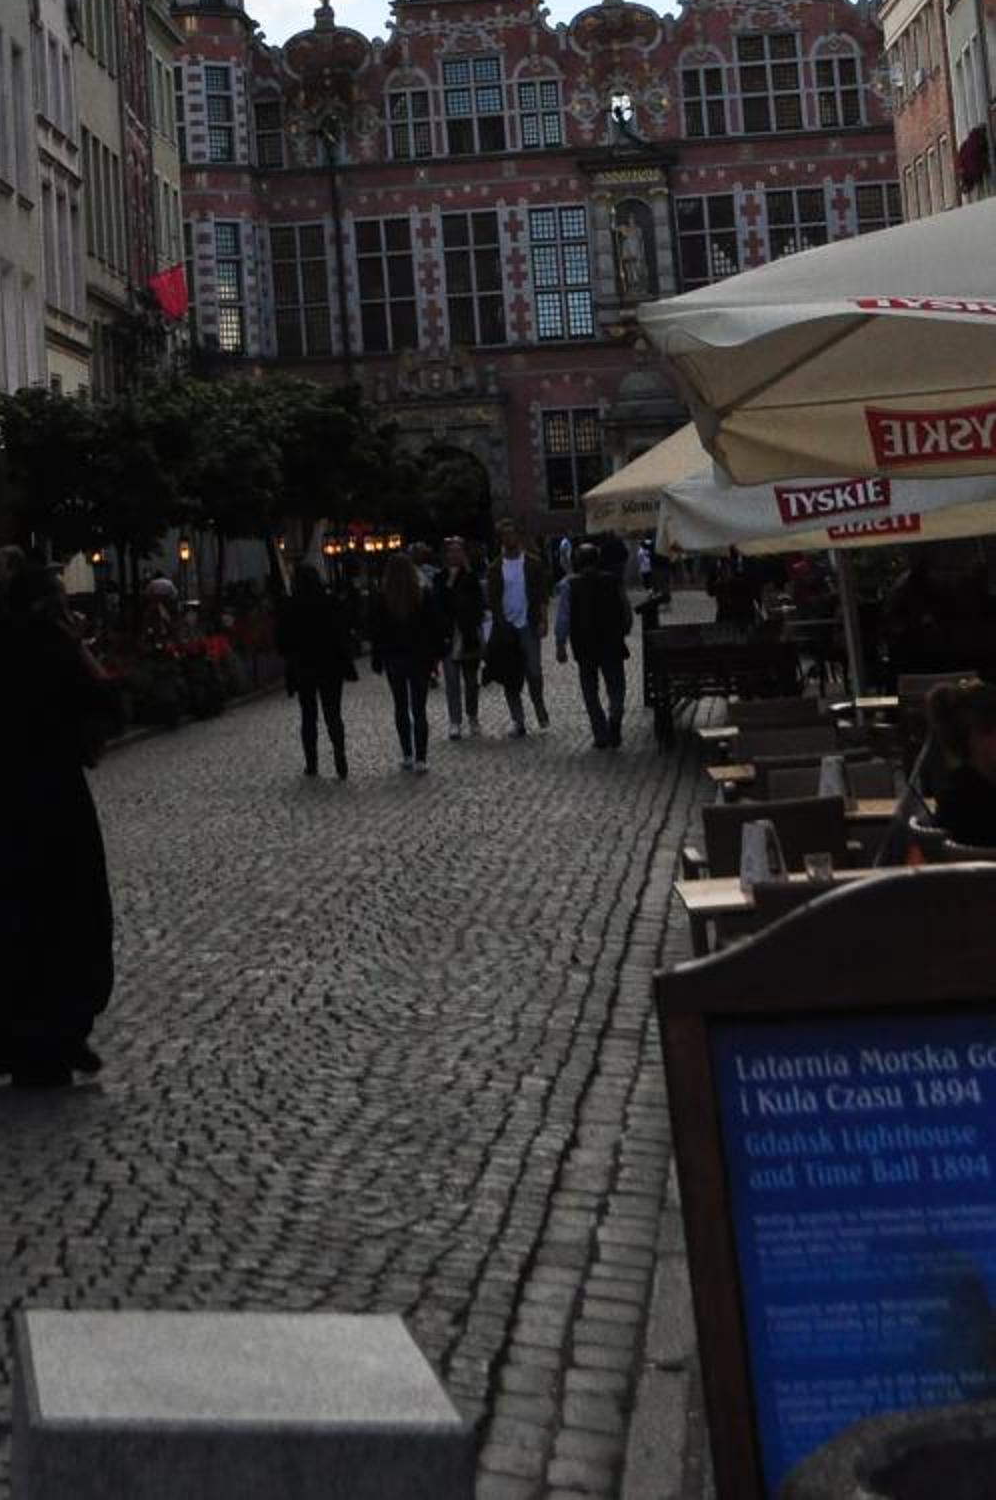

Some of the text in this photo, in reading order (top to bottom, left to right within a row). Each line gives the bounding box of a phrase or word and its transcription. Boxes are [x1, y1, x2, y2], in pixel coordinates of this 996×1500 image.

[783, 479, 884, 518] TYSKIE
[735, 1051, 850, 1081] Latarnia
[860, 1044, 959, 1074] Morska
[756, 1083, 820, 1116] Kula
[825, 1082, 904, 1112] Czasu
[913, 1075, 982, 1109] 1894
[842, 1123, 975, 1153] Lighthouse
[748, 1153, 989, 1190] and Time Ball 1894
